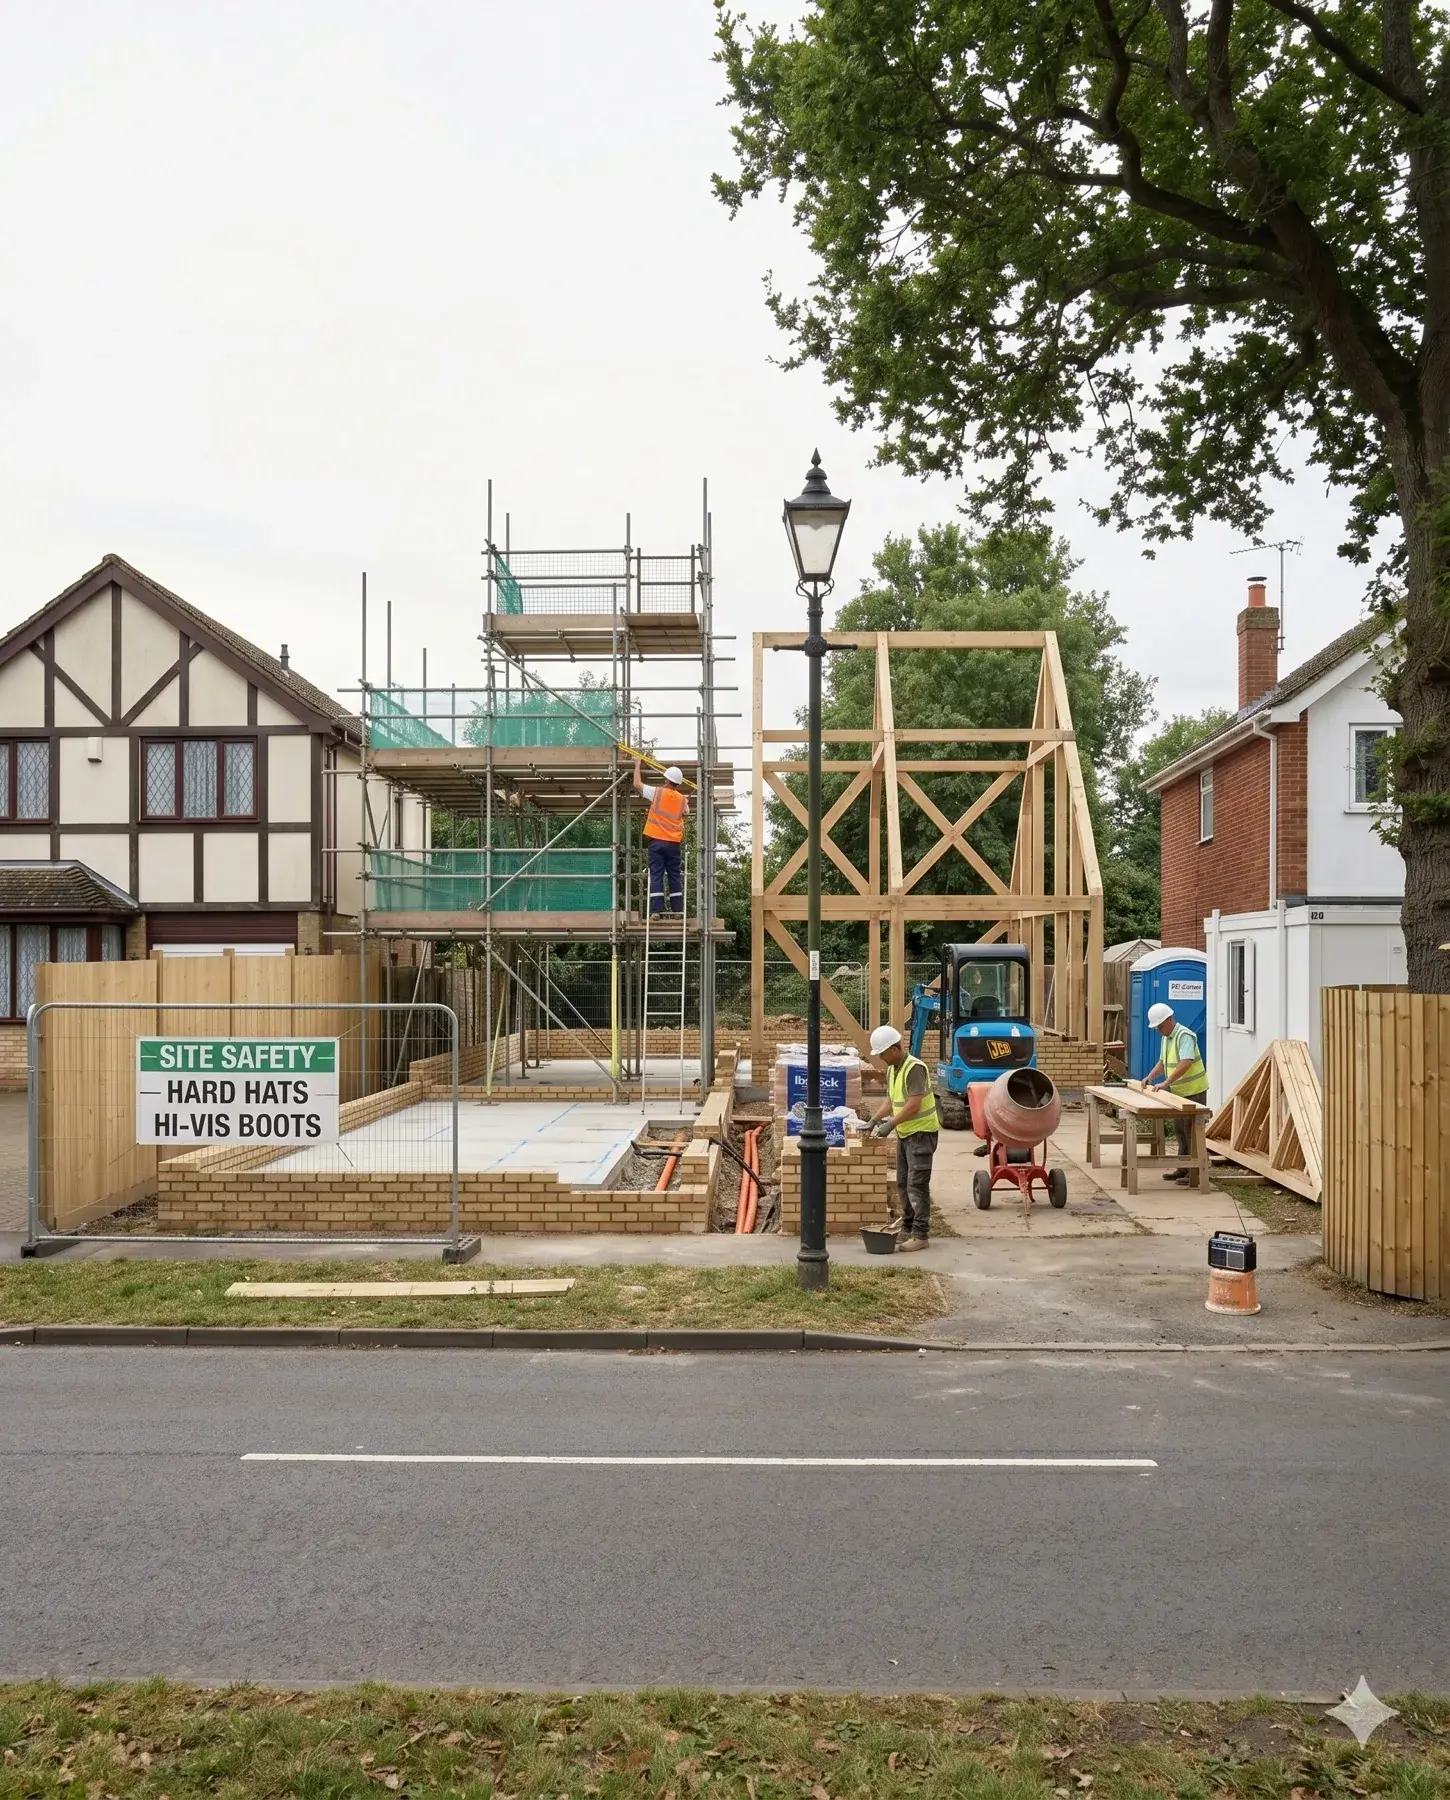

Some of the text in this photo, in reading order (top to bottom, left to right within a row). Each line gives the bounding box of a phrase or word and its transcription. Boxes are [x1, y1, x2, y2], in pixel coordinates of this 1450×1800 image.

[160, 1044, 316, 1069] SITE SAFETY
[990, 1040, 1010, 1058] JCB
[167, 1080, 309, 1105] HARD HATS
[155, 1112, 321, 1138] HI-VIS BOOTS
